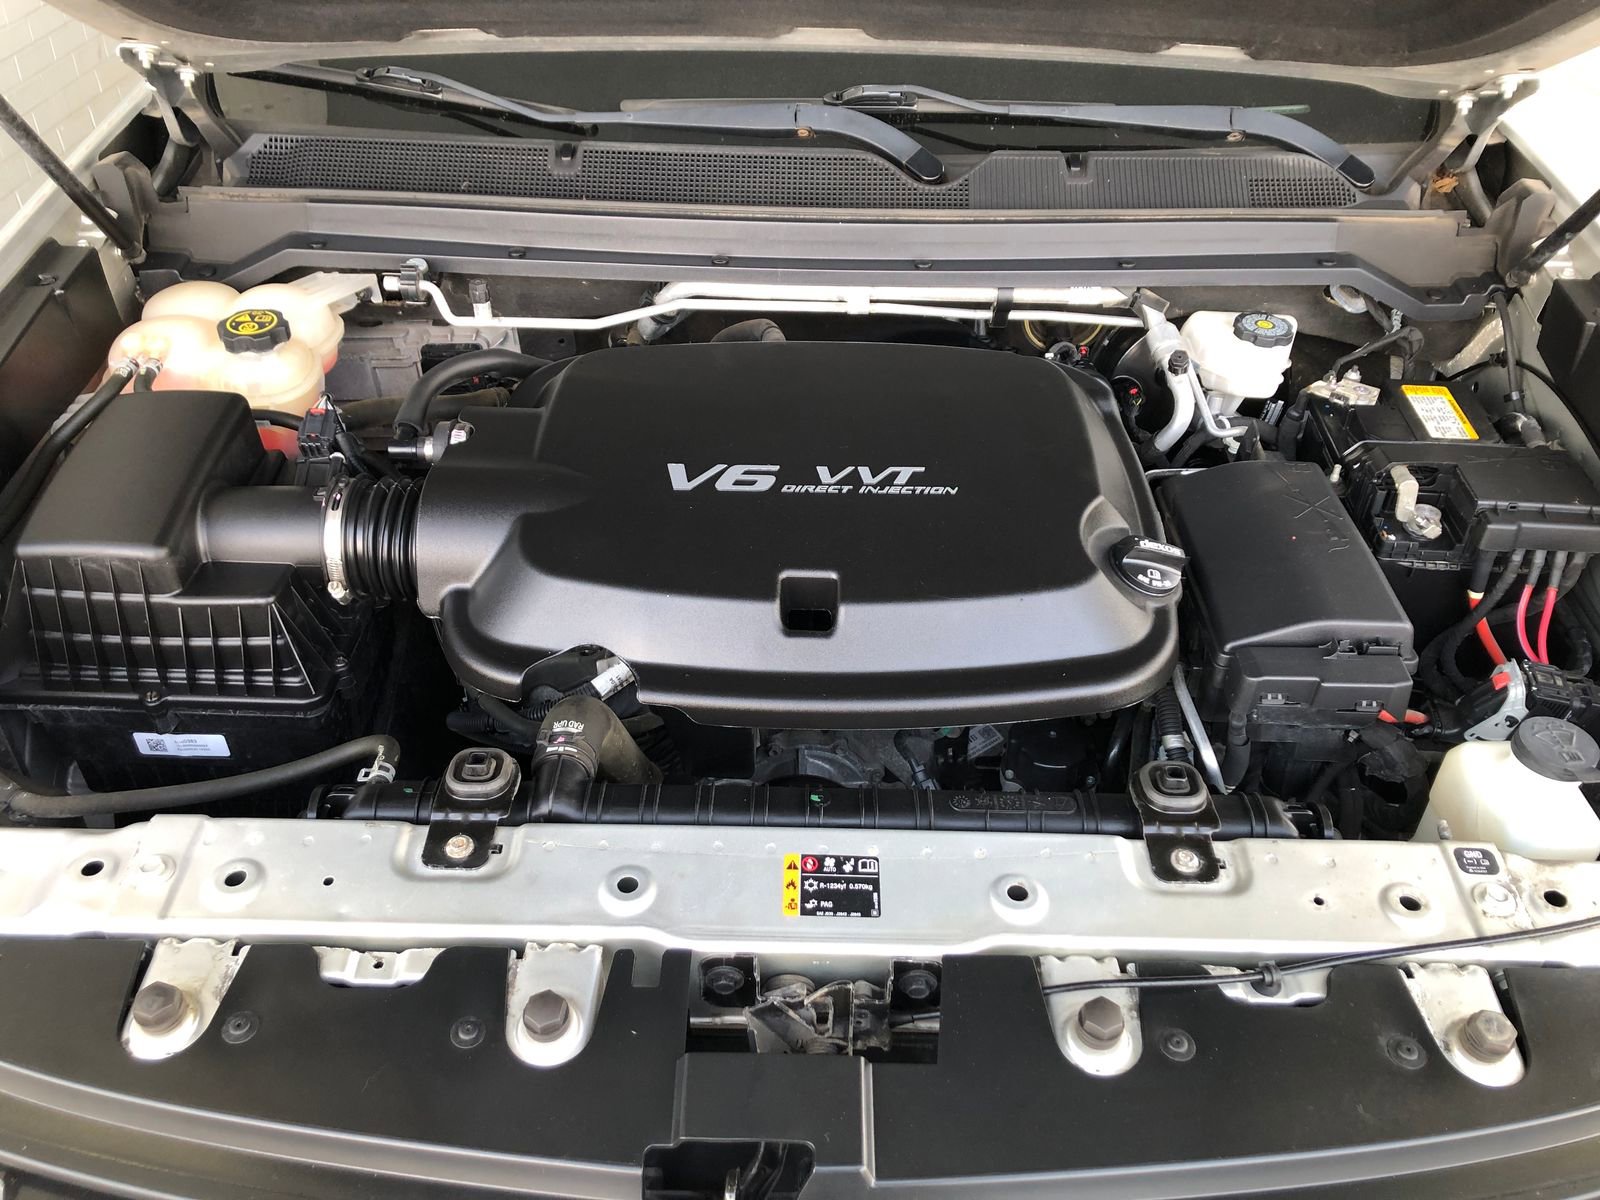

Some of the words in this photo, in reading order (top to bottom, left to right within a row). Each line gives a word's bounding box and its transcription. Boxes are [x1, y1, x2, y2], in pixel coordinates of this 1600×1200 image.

[667, 463, 780, 491] V6
[816, 465, 926, 485] VVT
[781, 485, 853, 494] DIRECT
[858, 485, 959, 495] INJECTION
[552, 719, 568, 729] UPR
[568, 720, 585, 730] RAD
